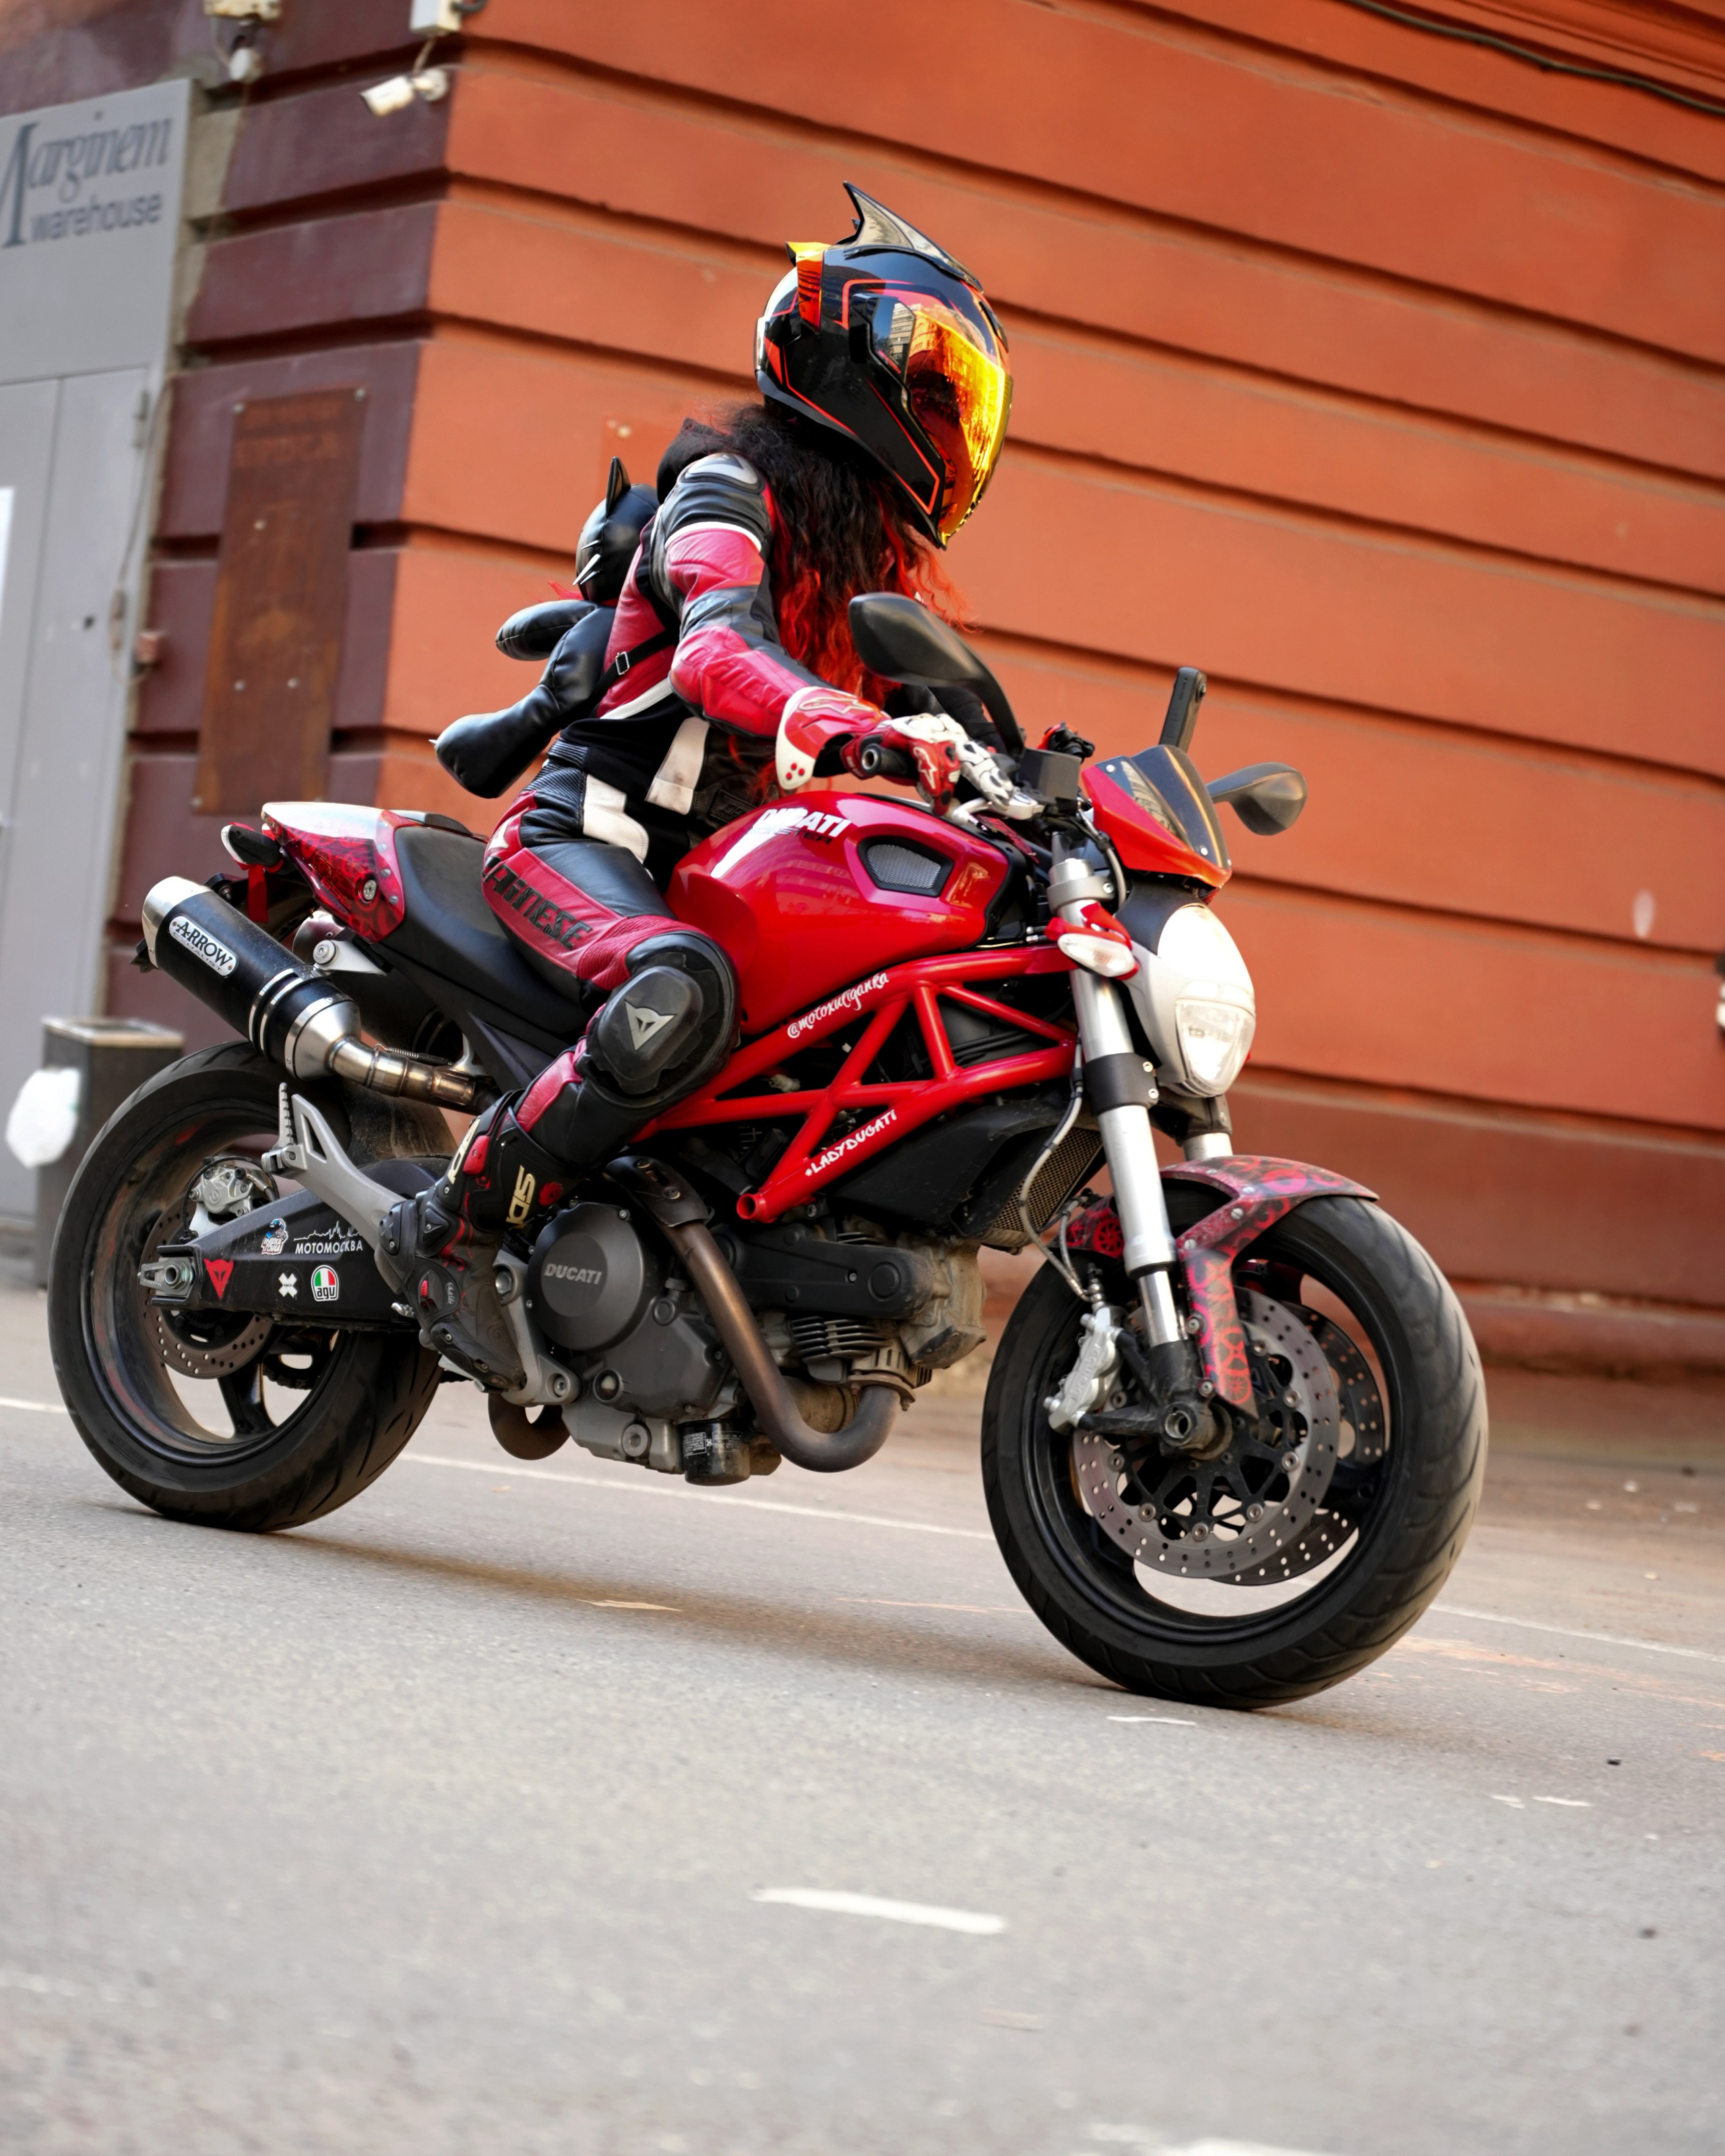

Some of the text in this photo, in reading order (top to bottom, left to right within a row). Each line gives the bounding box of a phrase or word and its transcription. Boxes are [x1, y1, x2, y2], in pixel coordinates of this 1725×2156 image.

[32, 194, 162, 242] warehouse
[172, 932, 223, 972] EXHAUST
[176, 921, 233, 968] ARROW
[317, 1286, 336, 1300] agv
[544, 1263, 602, 1285] DUCATI
